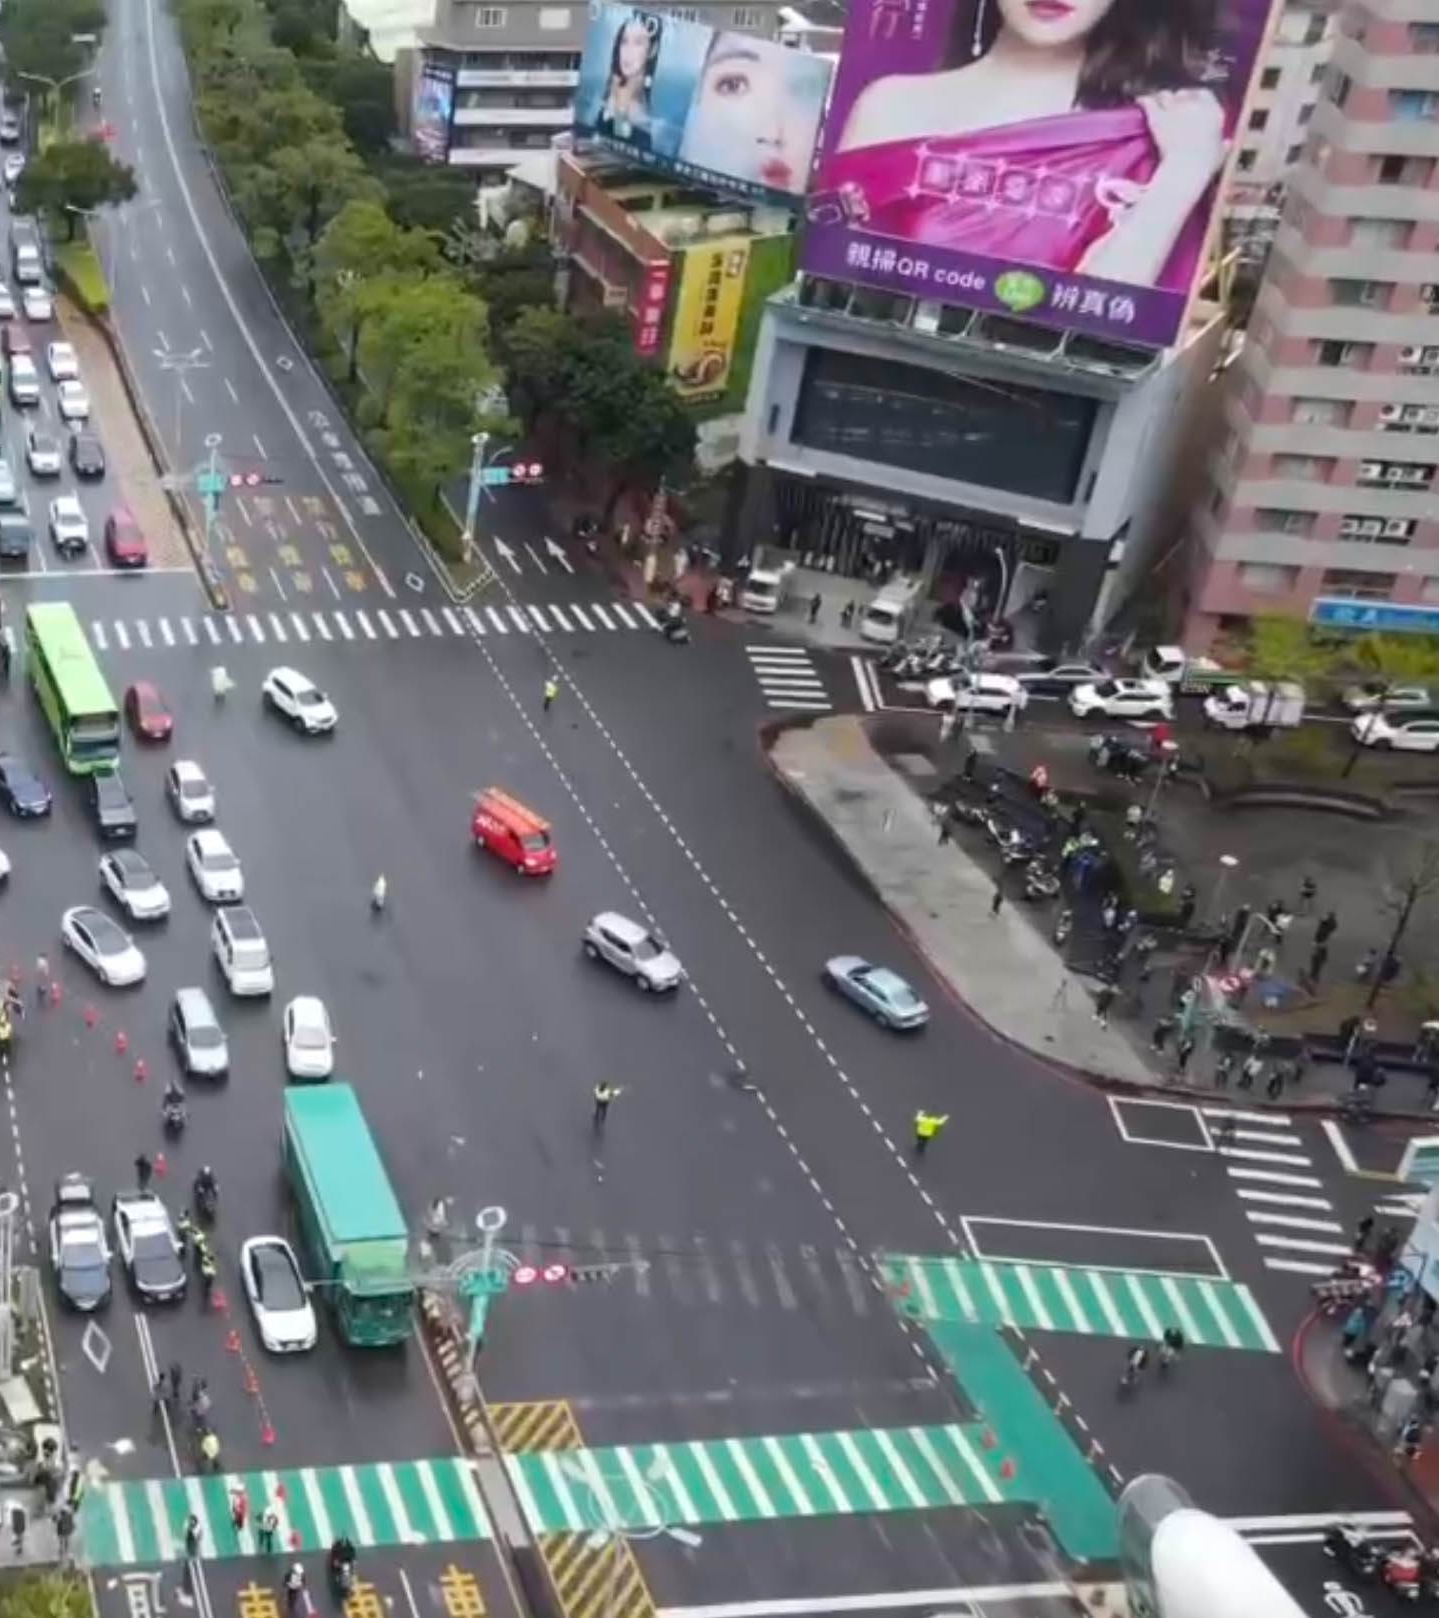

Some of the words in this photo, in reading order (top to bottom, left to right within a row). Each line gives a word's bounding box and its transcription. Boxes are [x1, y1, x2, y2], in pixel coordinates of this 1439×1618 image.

[934, 264, 986, 290] code
[1050, 282, 1136, 323] 辨真偽
